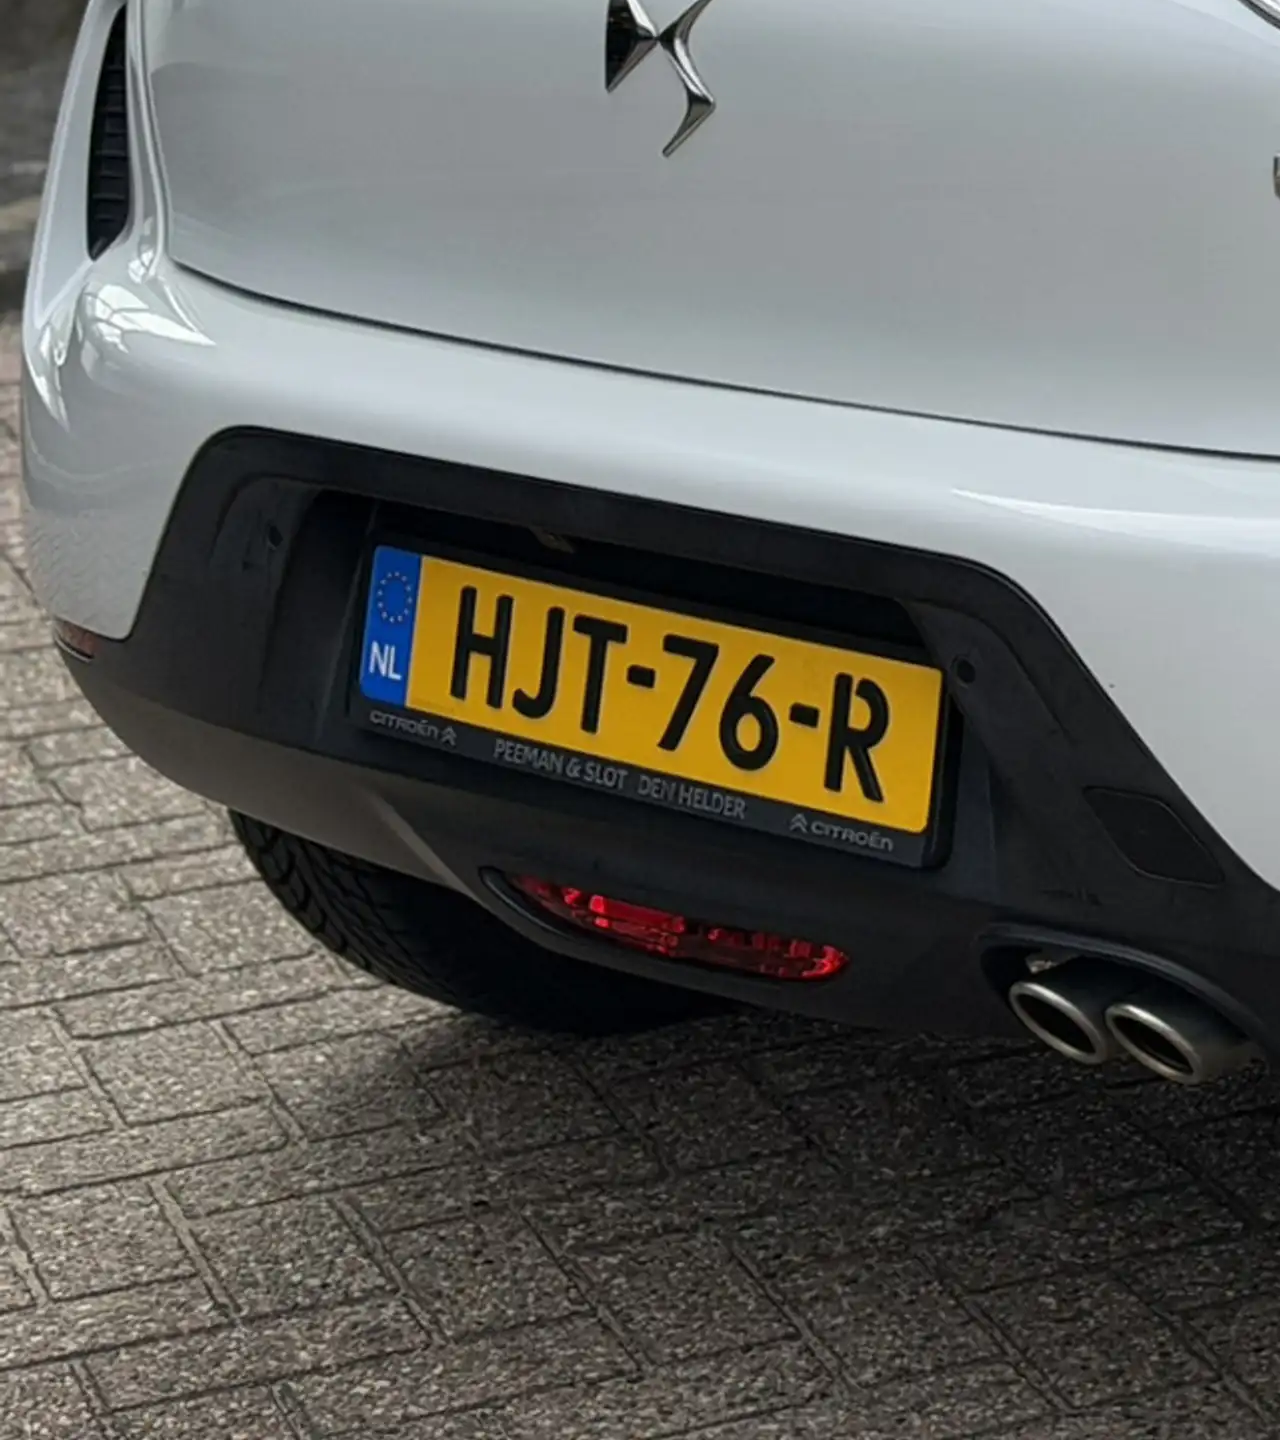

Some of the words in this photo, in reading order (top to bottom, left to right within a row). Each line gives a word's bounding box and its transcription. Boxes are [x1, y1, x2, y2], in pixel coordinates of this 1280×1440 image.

[369, 641, 402, 680] NL
[449, 585, 890, 803] HJT-76-R
[493, 738, 564, 774] PEEMAN
[565, 757, 580, 778] &
[583, 761, 629, 790] SLOT
[636, 775, 676, 800] DEN
[677, 786, 746, 821] HELDER
